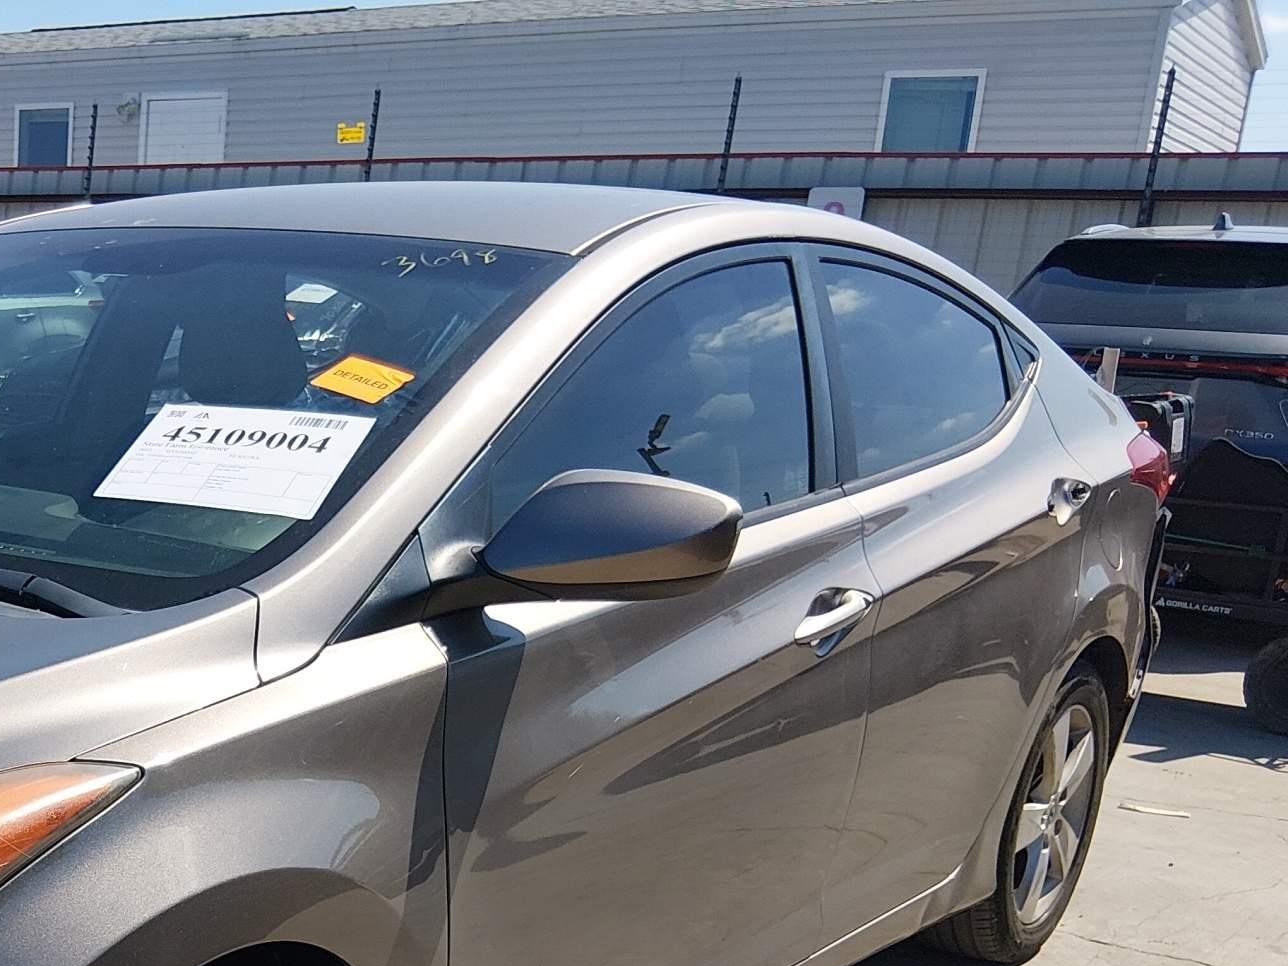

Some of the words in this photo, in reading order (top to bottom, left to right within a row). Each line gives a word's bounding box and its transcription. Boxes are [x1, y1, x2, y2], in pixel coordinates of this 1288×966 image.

[333, 368, 389, 391] DETAILED
[162, 425, 332, 454] 45109004
[1166, 600, 1200, 610] GORILLA
